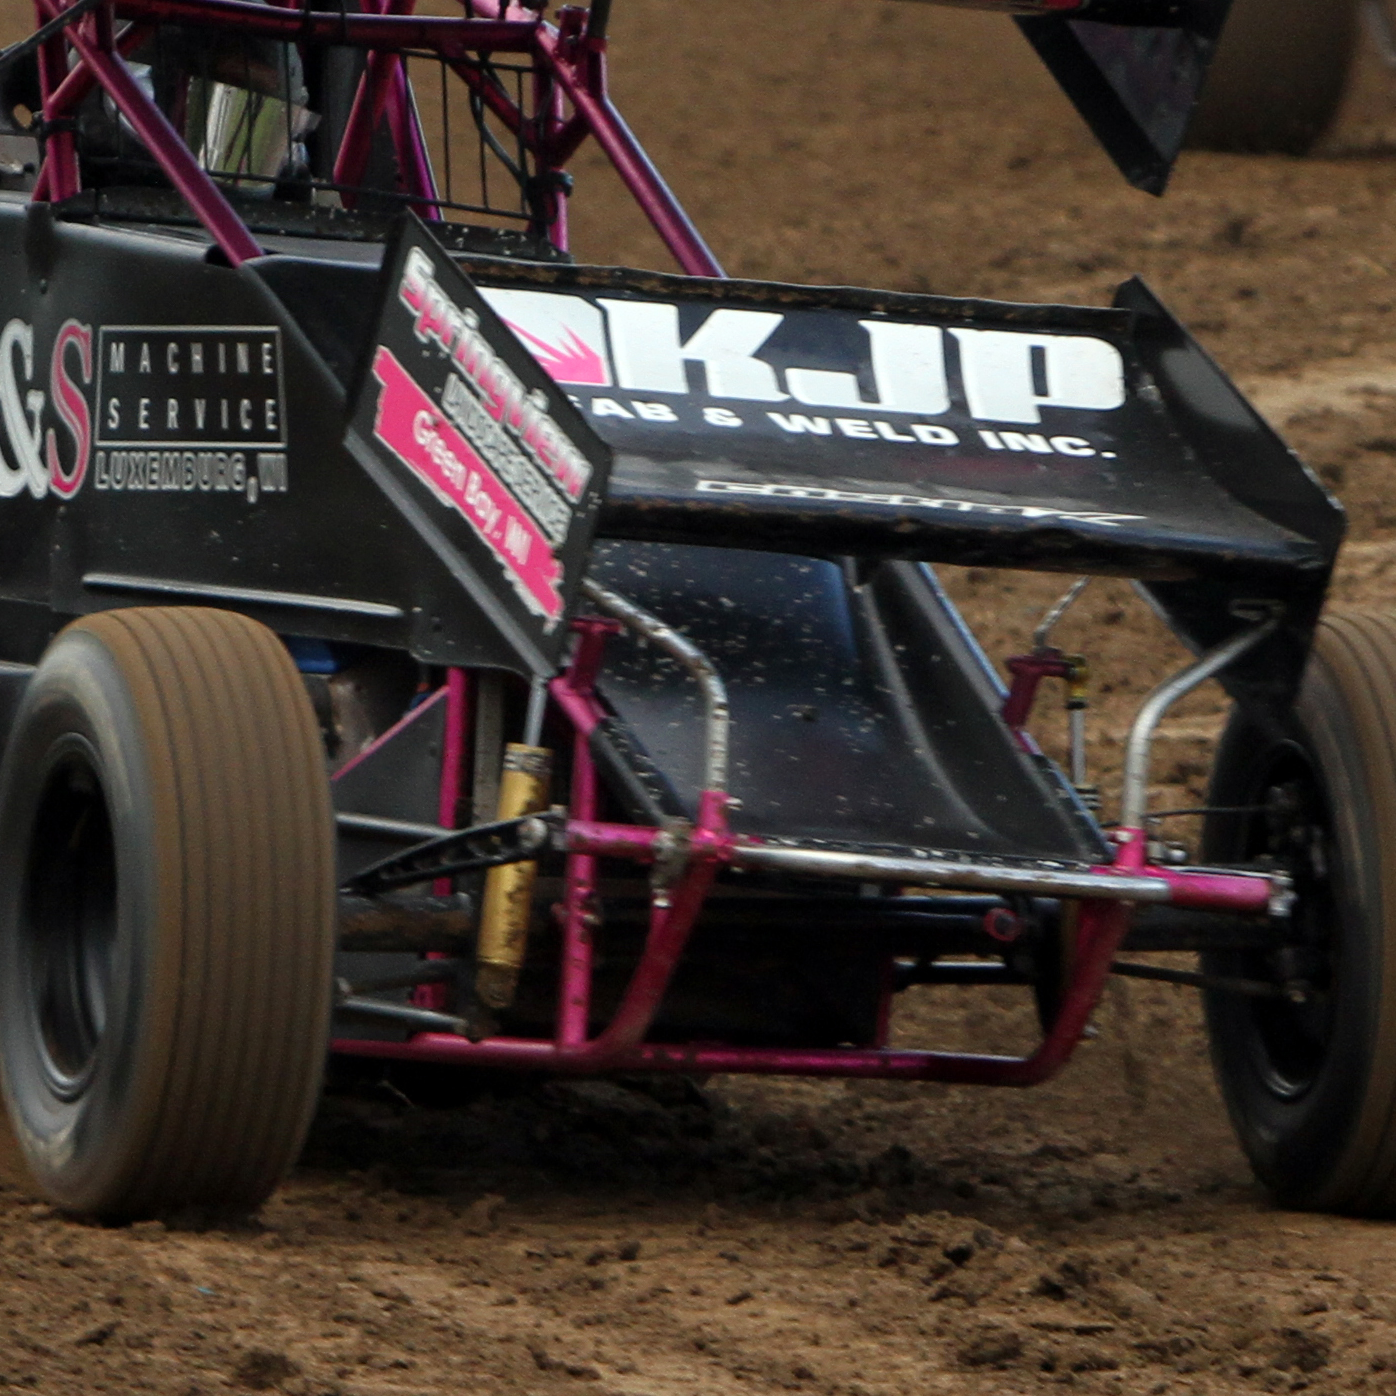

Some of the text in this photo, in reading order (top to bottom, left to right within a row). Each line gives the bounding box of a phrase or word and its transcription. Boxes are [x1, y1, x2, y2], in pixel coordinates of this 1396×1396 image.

[110, 341, 274, 374] MACHINE
[399, 246, 593, 504] Springview
[596, 297, 1125, 424] KJP
[108, 397, 278, 432] SERVICE
[571, 395, 1117, 459] AB & WELD INC.
[414, 410, 466, 490] Green
[505, 516, 532, 565] WI
